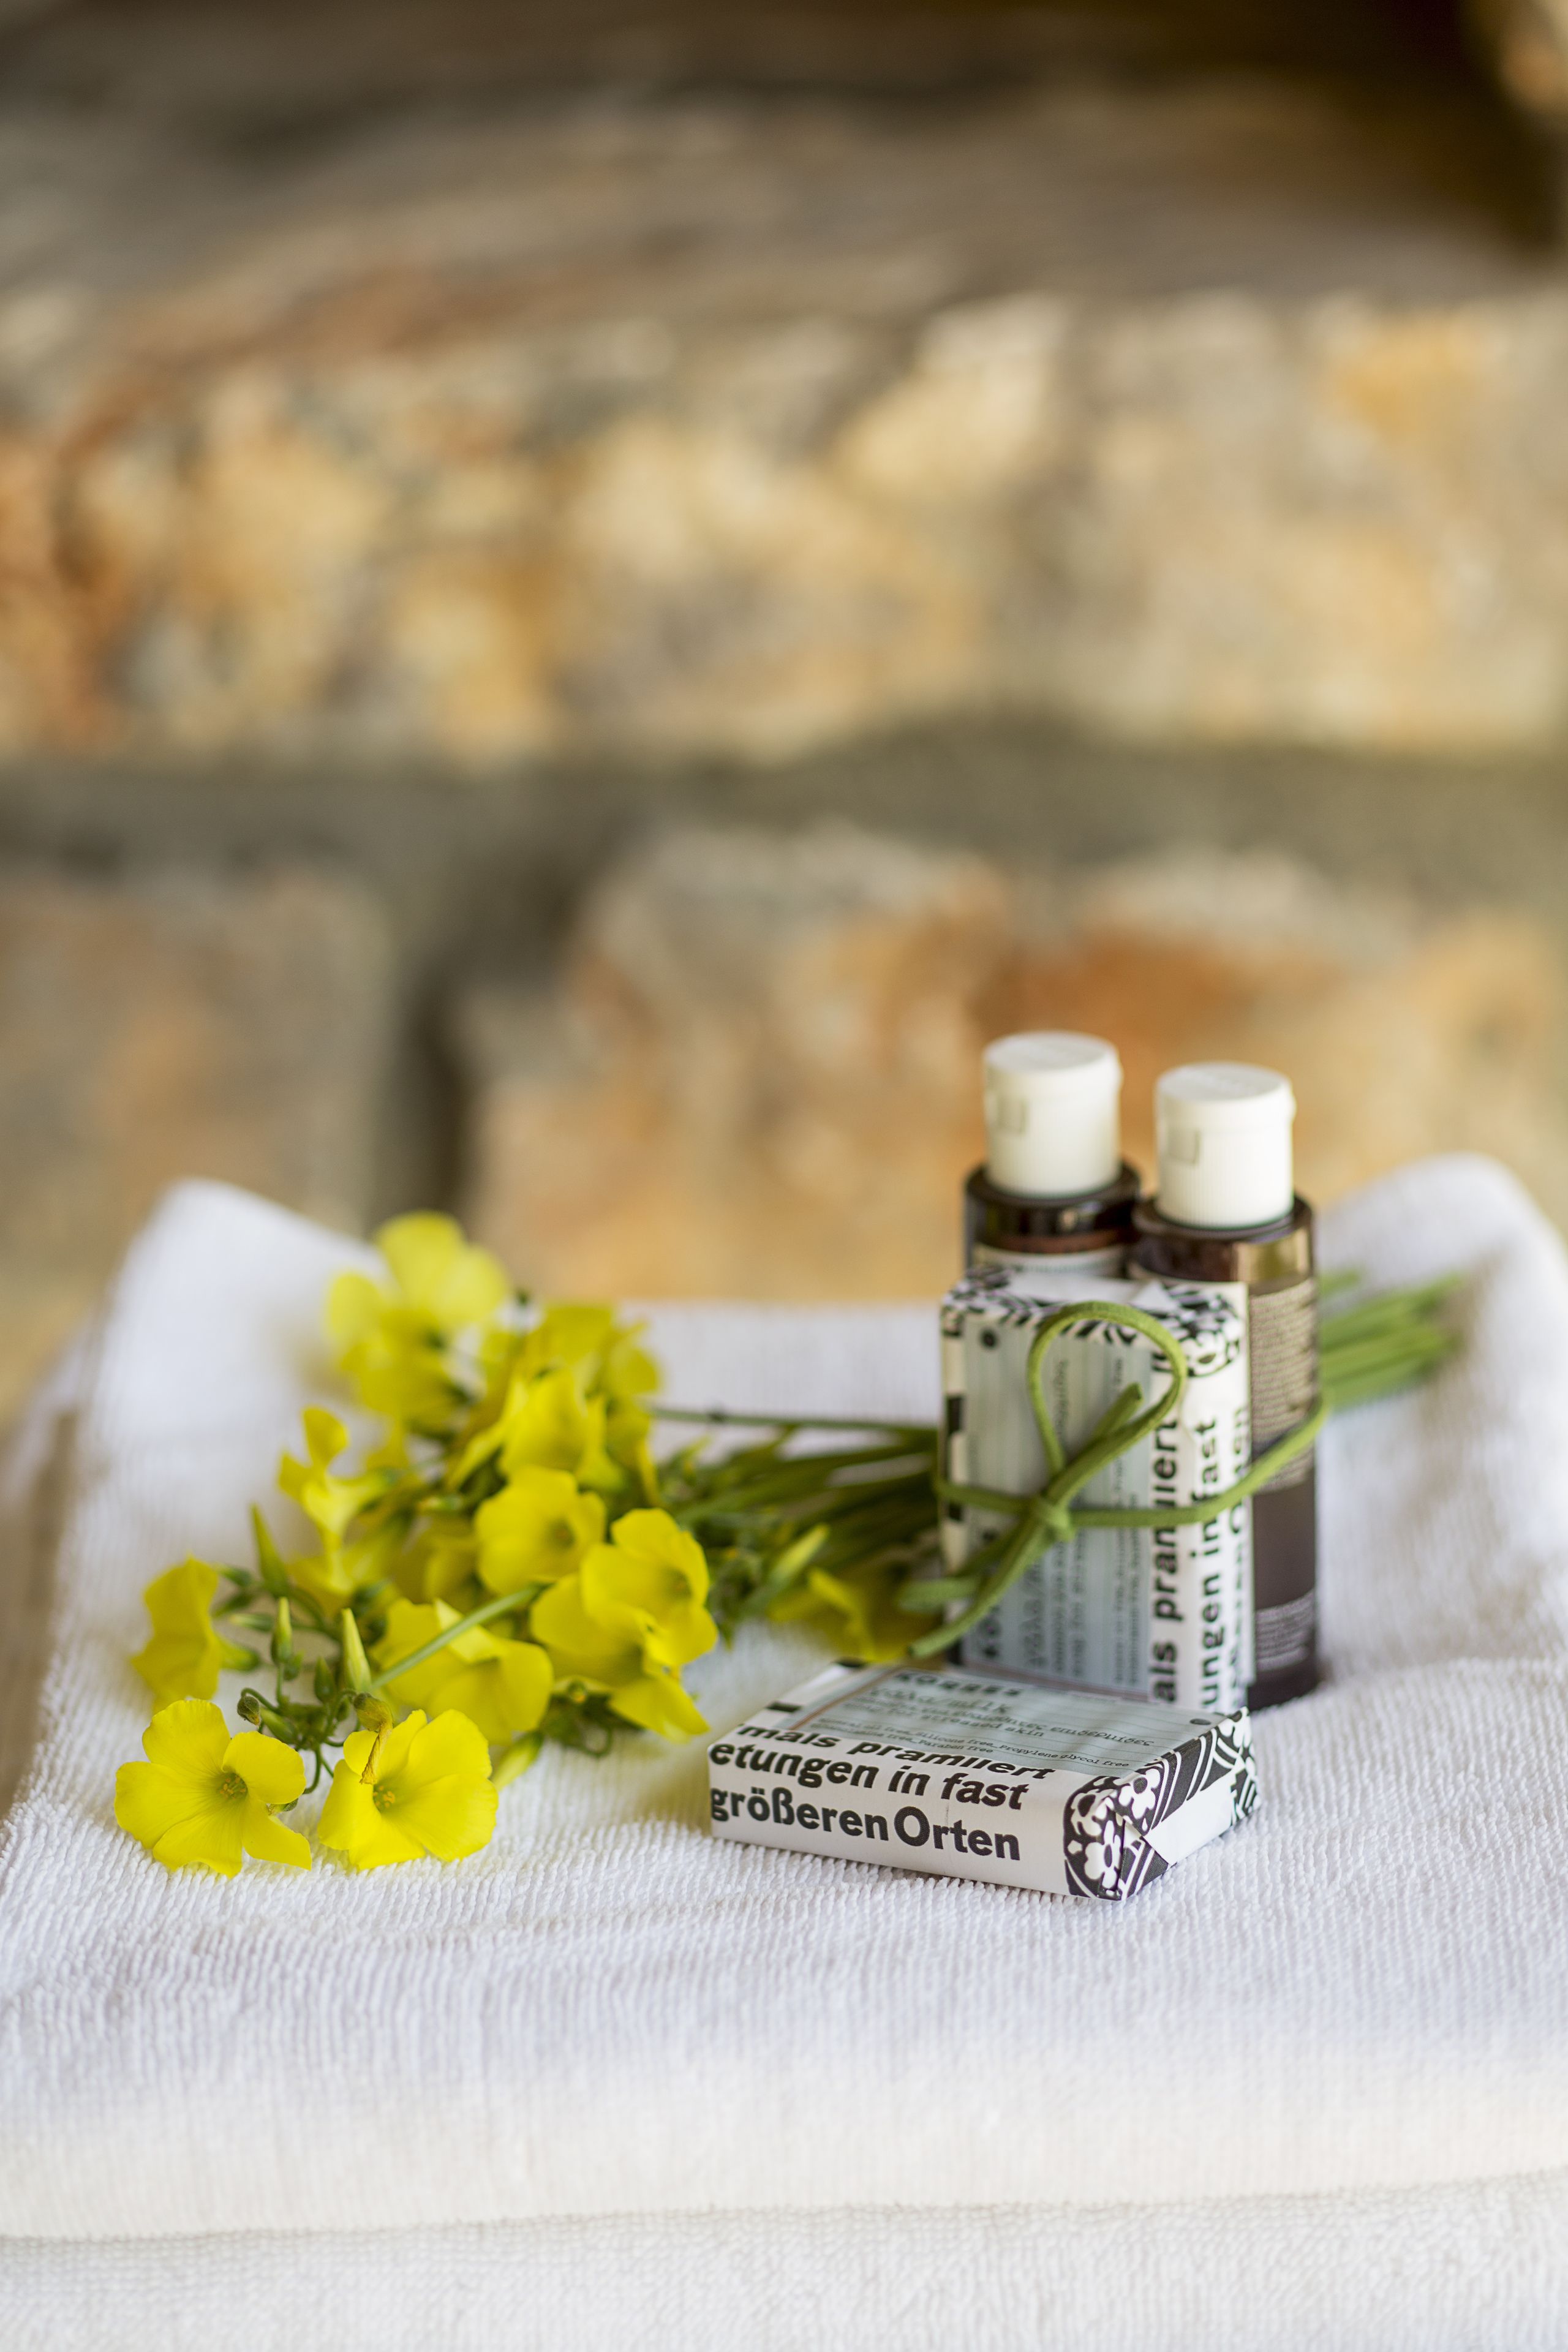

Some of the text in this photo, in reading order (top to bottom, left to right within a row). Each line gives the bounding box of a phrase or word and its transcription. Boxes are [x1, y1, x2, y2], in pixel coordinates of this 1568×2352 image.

[1005, 1724, 1044, 1737] skin
[709, 1743, 1029, 1811] etungen in fast
[1060, 1753, 1099, 1765] glycol
[1102, 1758, 1129, 1767] free
[711, 1786, 1020, 1861] größeren Orten
